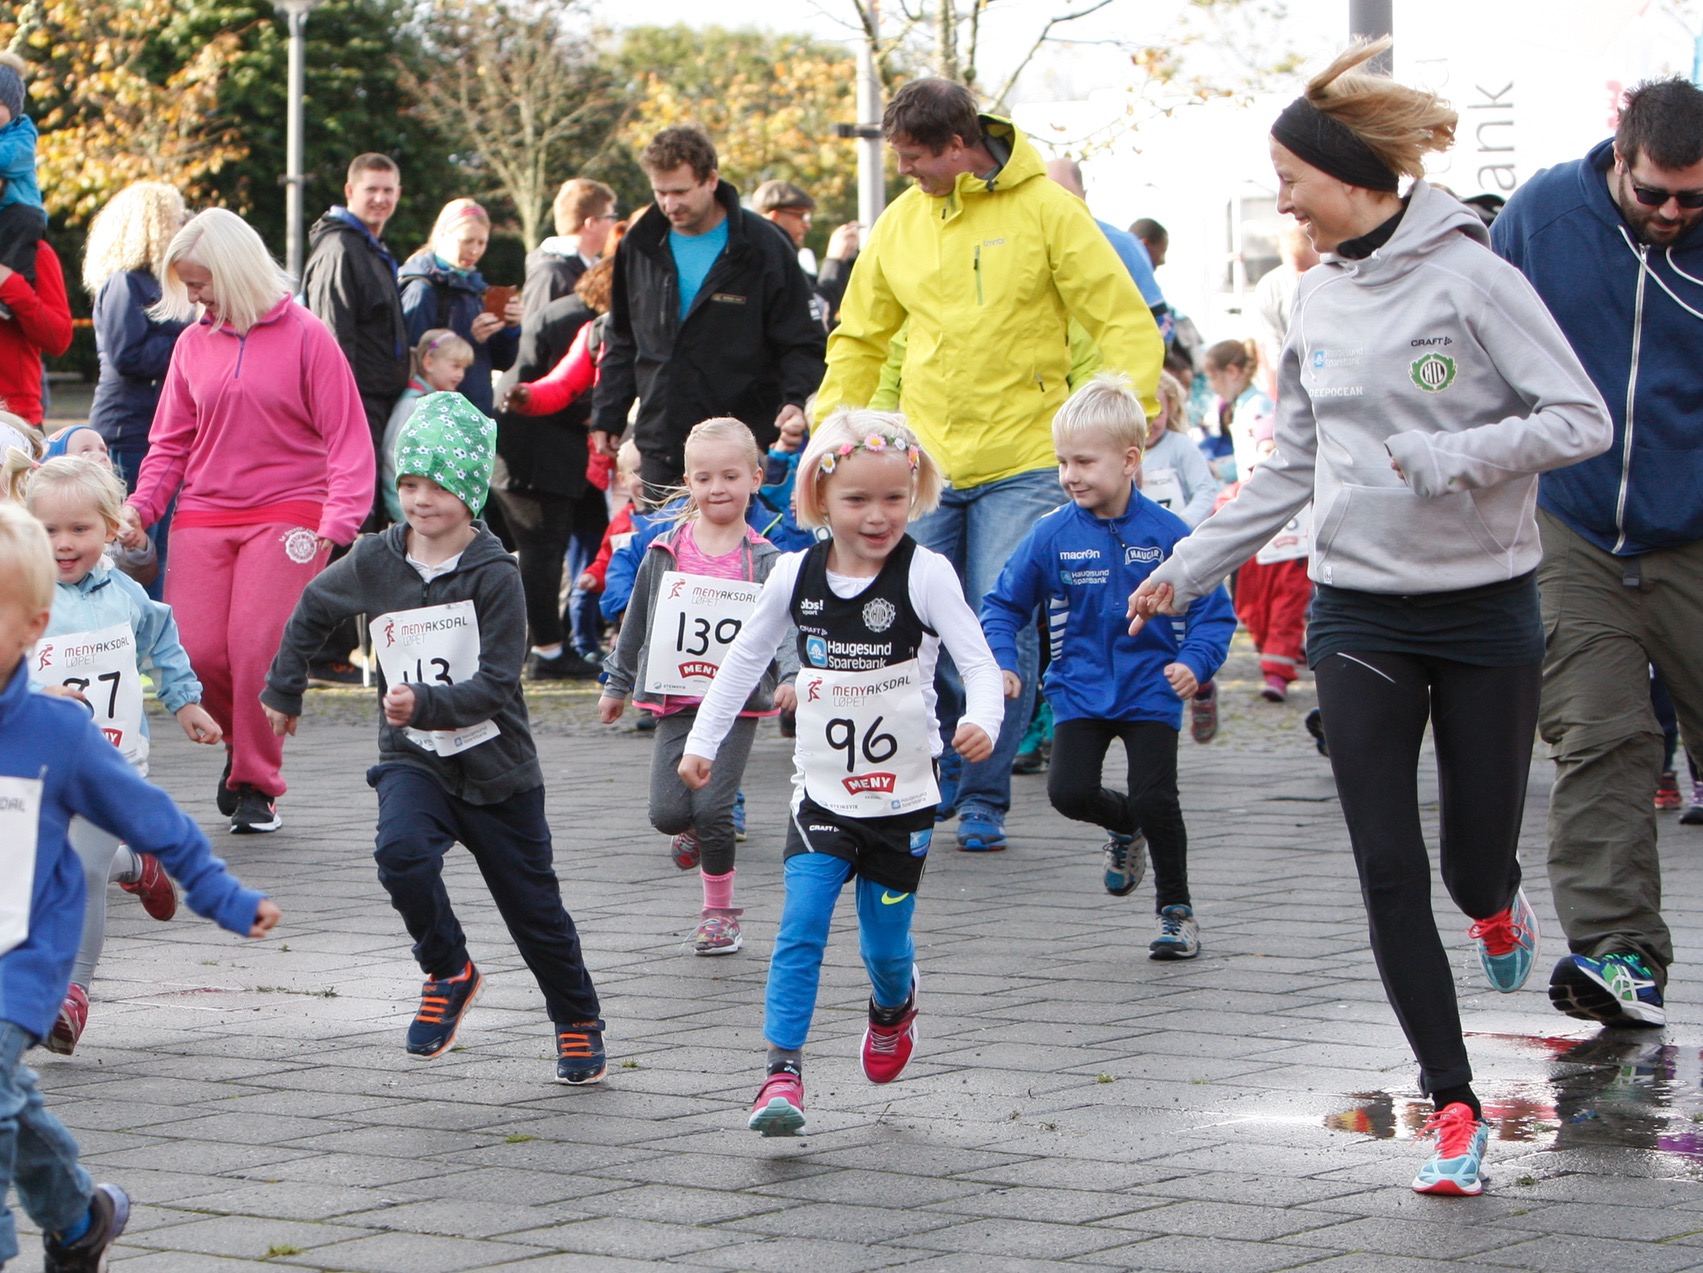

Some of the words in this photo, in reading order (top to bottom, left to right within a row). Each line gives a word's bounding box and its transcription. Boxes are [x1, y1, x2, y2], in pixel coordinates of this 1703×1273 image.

[1411, 338, 1443, 347] CRAFT
[1309, 386, 1363, 398] DEEPOCEAN
[1060, 549, 1100, 560] macron
[401, 615, 468, 635] MENYAKSDAL
[64, 636, 130, 658] MENYAKSDAL
[827, 640, 892, 655] Haugesund
[65, 654, 97, 668] LØPET
[828, 656, 887, 669] Sparebank
[833, 676, 911, 697] MENYAKSDAL
[833, 695, 867, 708] LØPET
[825, 715, 898, 773] 96
[848, 776, 891, 790] MENY
